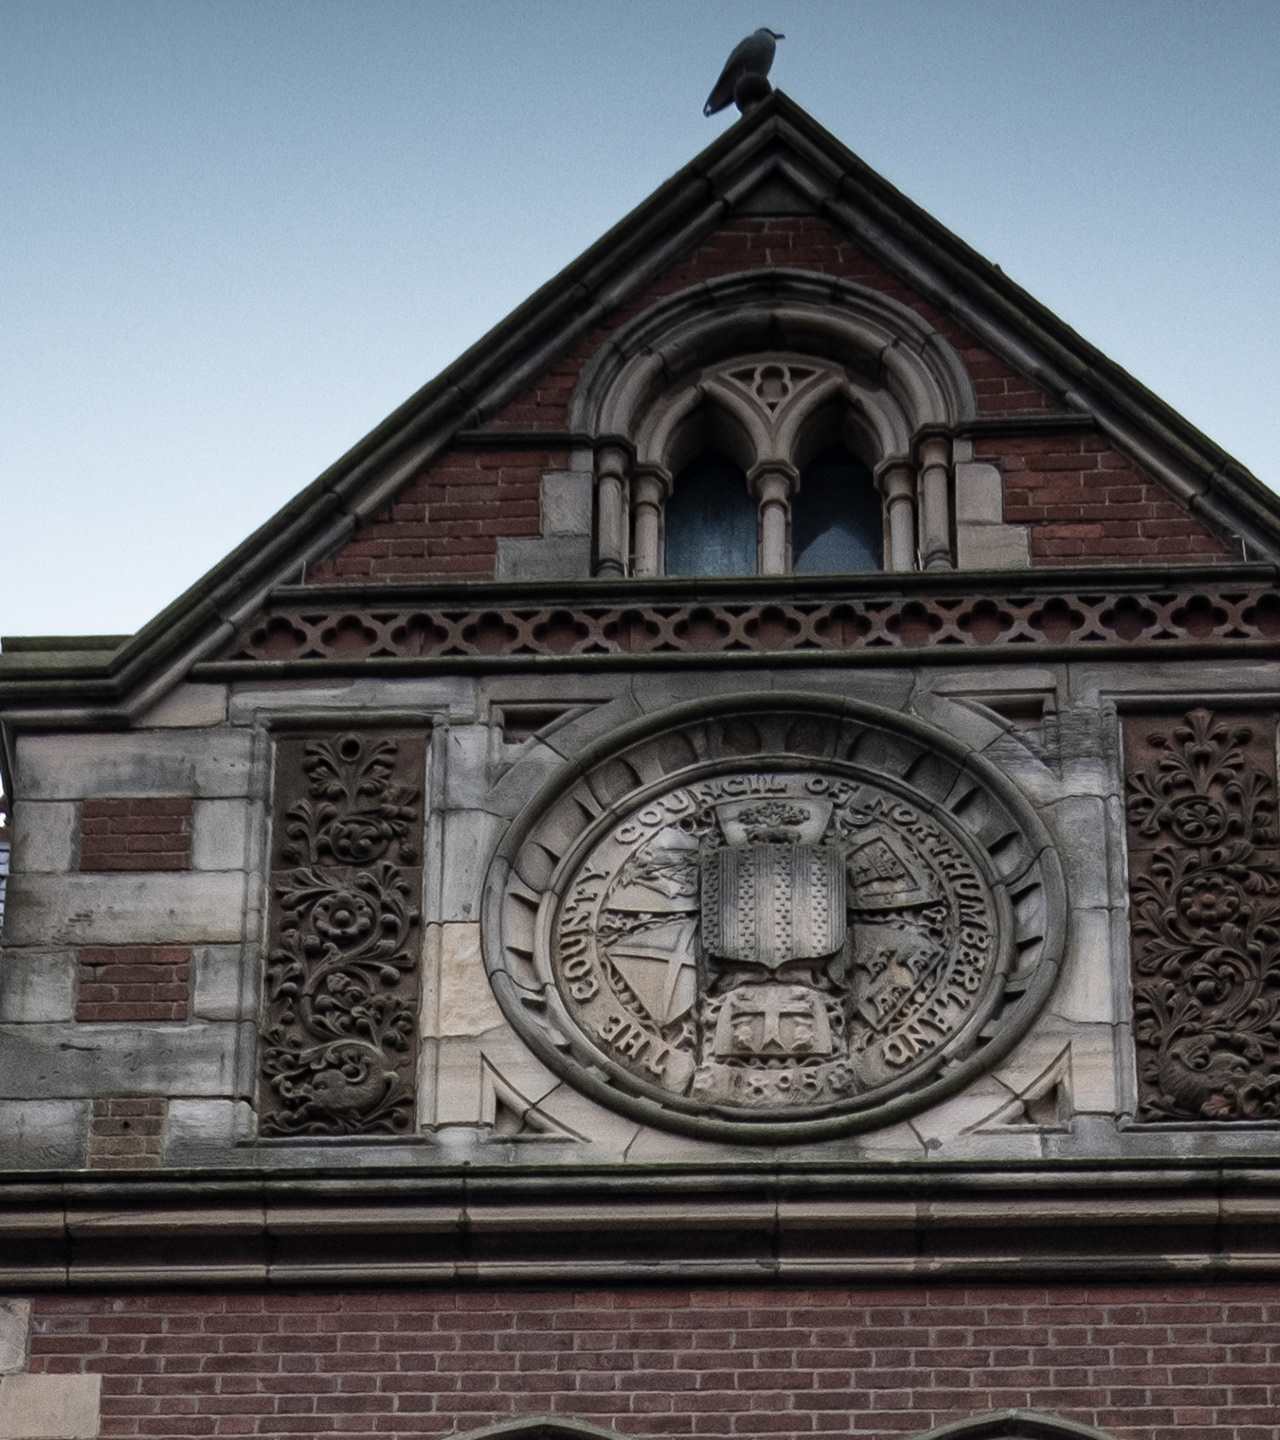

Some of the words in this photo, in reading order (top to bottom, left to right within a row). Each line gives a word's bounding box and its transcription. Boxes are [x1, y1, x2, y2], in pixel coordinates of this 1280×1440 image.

[614, 775, 787, 845] COUNCIL
[804, 776, 861, 800] OF
[559, 863, 610, 1005] COUNTY
[861, 797, 991, 1069] NORTHUMBERLAND
[598, 1015, 671, 1075] THE
